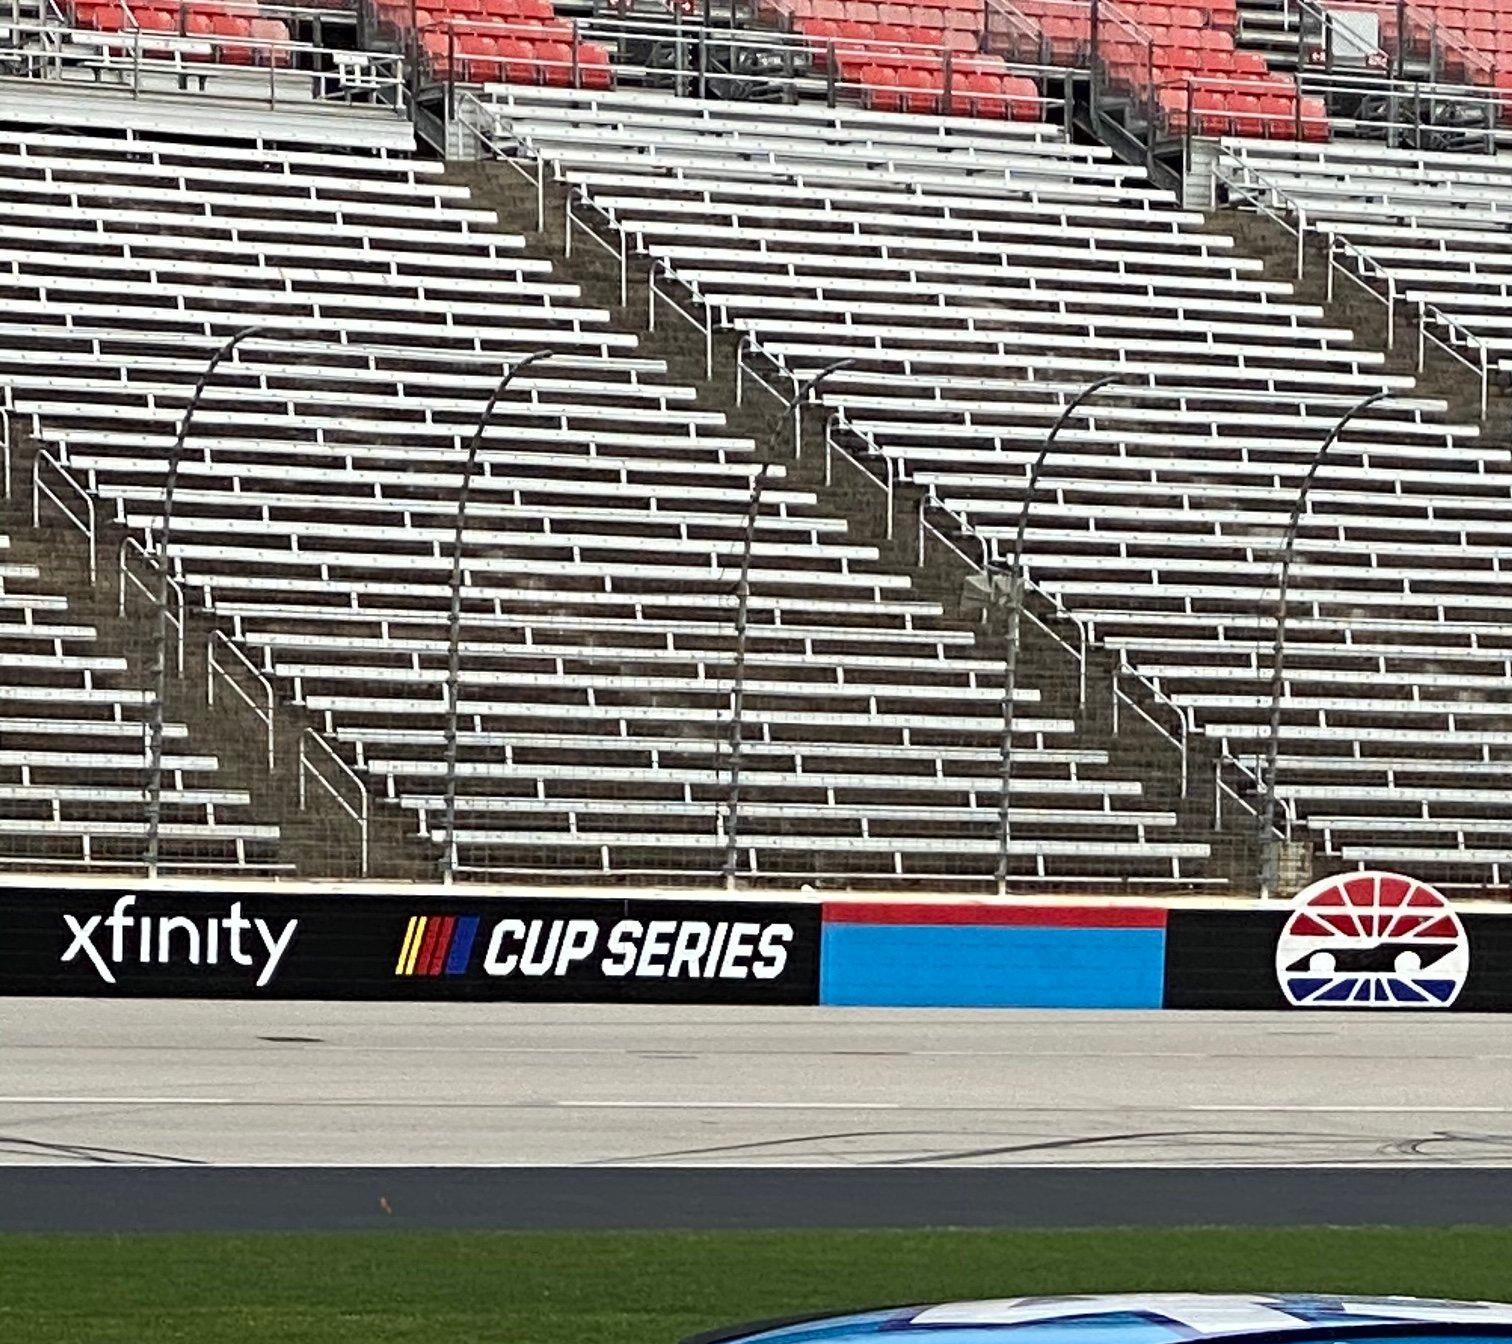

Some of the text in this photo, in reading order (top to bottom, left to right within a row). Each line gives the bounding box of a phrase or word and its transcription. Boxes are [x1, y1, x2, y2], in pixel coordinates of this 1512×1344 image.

[60, 895, 298, 986] xfinity
[485, 917, 795, 981] CUP SERIES
